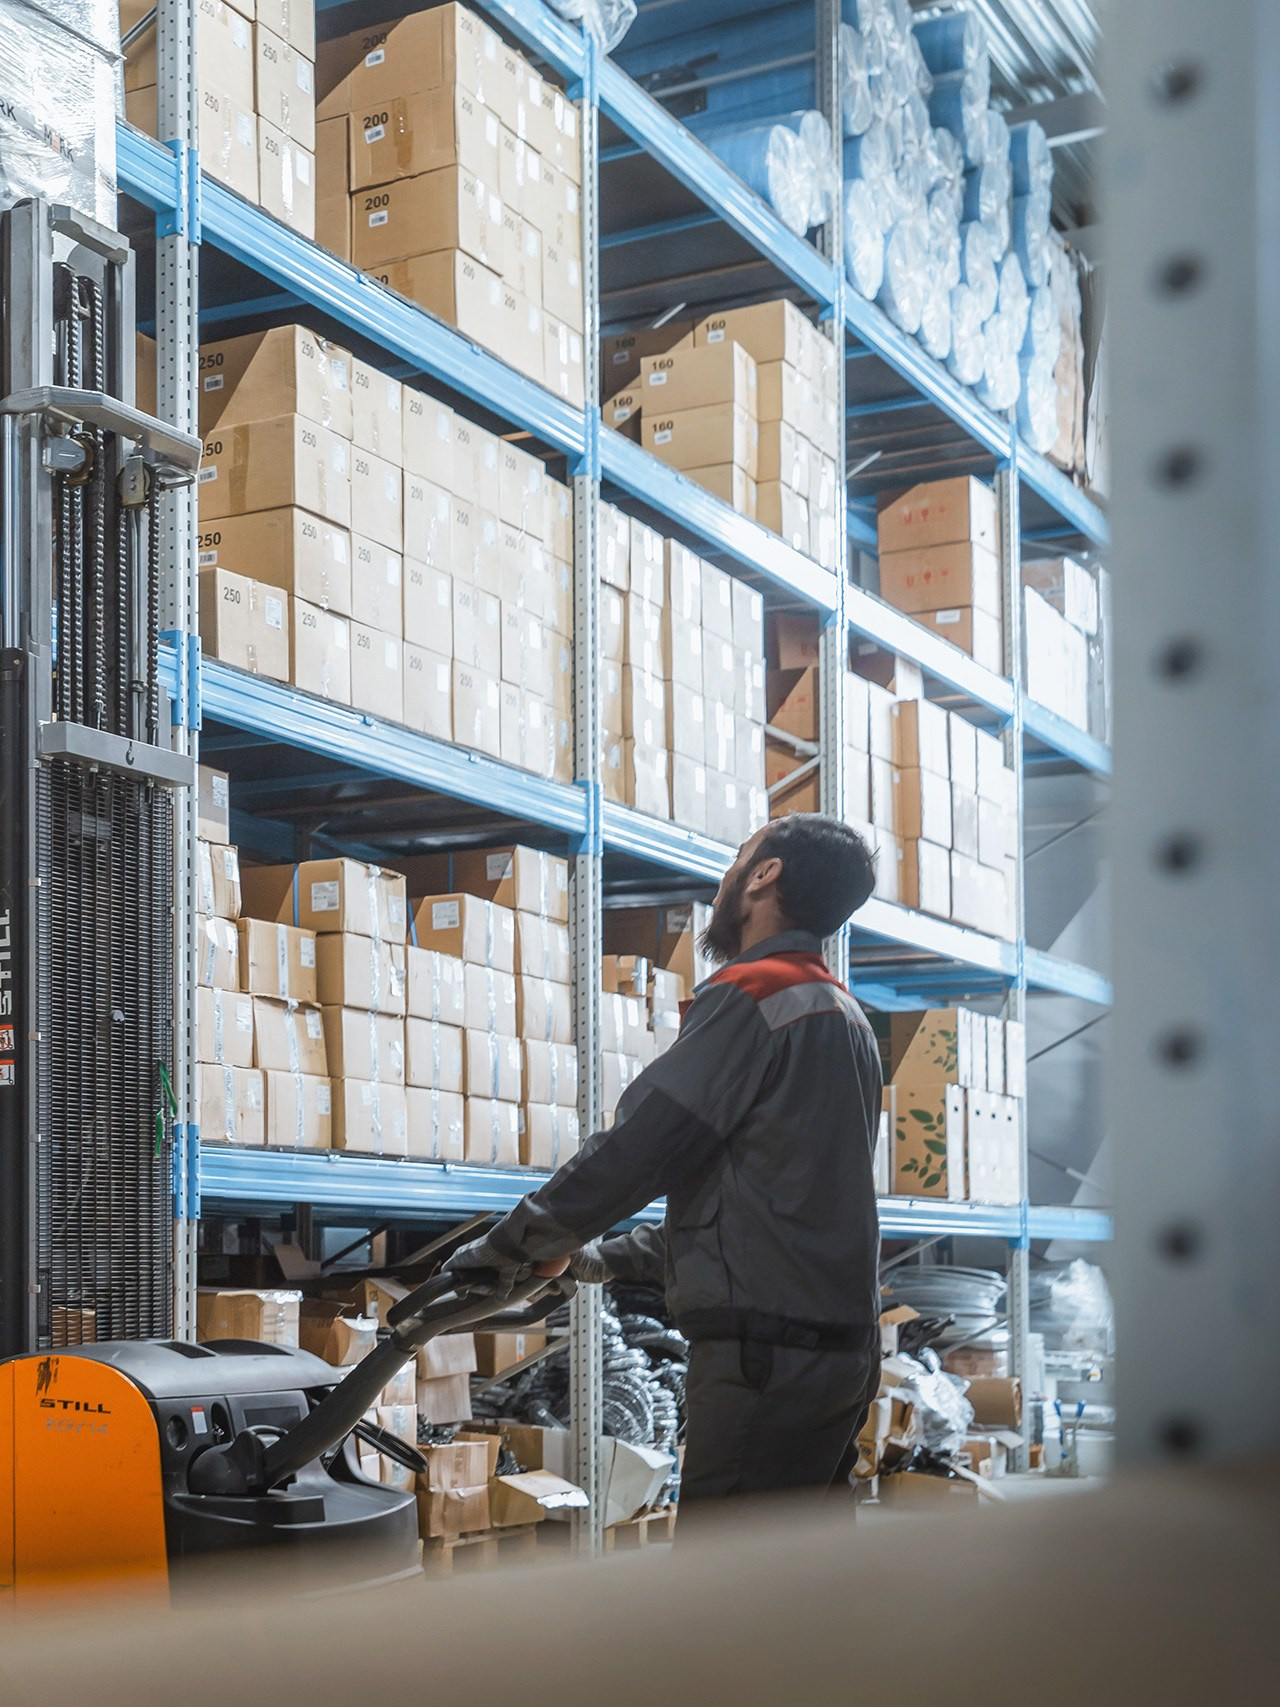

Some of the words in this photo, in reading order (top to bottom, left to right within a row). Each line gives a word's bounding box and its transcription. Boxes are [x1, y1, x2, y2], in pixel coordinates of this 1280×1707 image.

[362, 32, 387, 50] 200
[262, 43, 278, 63] 250
[204, 91, 219, 112] 250
[363, 112, 388, 129] 200
[265, 136, 279, 156] 250
[365, 194, 390, 211] 200
[705, 319, 726, 332] 160
[301, 341, 314, 359] 250
[199, 353, 224, 370] 250
[652, 358, 674, 371] 160
[355, 371, 369, 389] 250
[409, 400, 423, 416] 250
[612, 396, 633, 408] 160
[652, 420, 674, 432] 160
[302, 430, 316, 447] 250
[355, 459, 369, 475] 250
[302, 522, 317, 539] 250
[197, 532, 221, 548] 250
[358, 547, 371, 563] 250
[223, 587, 241, 604] 250
[302, 612, 317, 628] 250
[357, 634, 370, 650] 250
[40, 1398, 111, 1414] STILL
